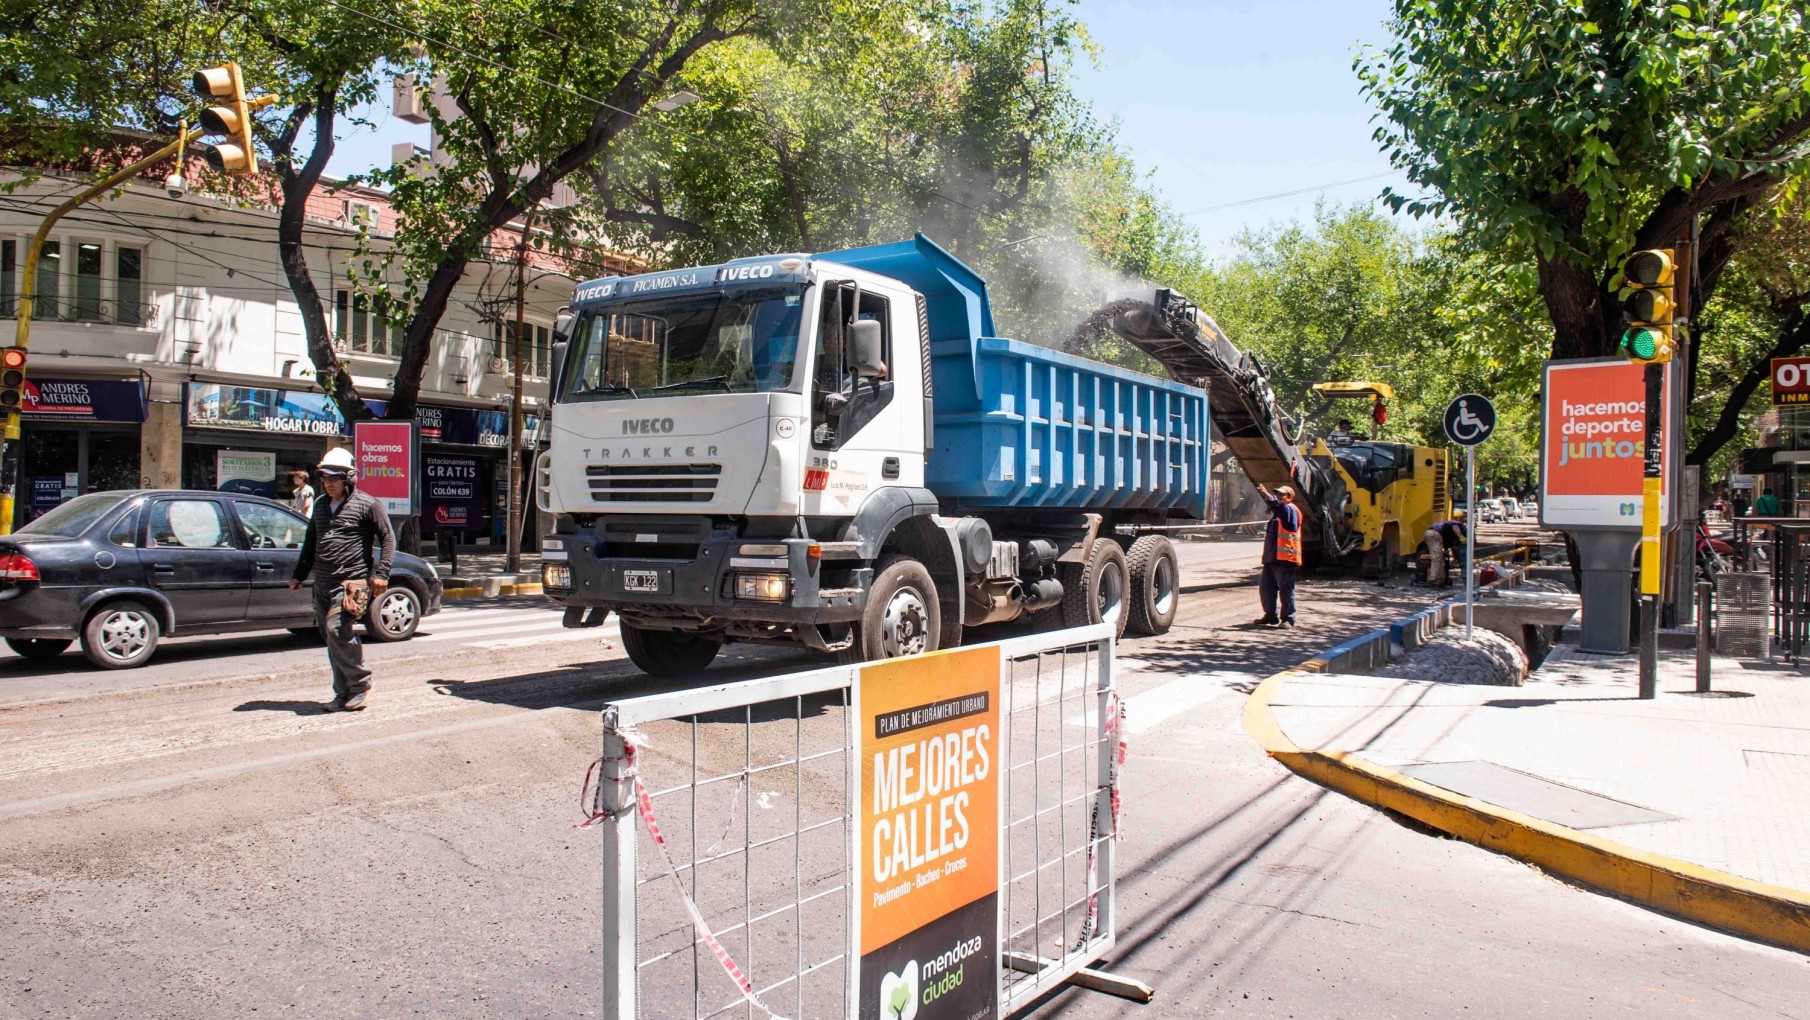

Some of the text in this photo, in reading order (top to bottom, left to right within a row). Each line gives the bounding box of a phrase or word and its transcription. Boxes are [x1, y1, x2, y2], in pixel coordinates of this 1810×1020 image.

[720, 264, 774, 282] IVECO
[632, 274, 698, 293] FICAMEN S.A.
[575, 284, 612, 303] IVECO
[40, 383, 89, 394] ANDRES
[42, 393, 91, 404] MERINO
[1781, 393, 1810, 402] INM
[416, 407, 442, 419] NDRES
[265, 416, 340, 435] HOGAR Y OBRA
[622, 418, 674, 435] IVECO
[1561, 417, 1643, 438] deporte
[362, 441, 402, 452] hacemos
[583, 445, 718, 459] TRAKKER
[1559, 436, 1645, 466] juntos
[263, 456, 271, 467] 3
[362, 452, 388, 462] obras
[427, 457, 475, 466] Estacionamiento
[361, 463, 404, 480] juntos.
[427, 466, 476, 478] GRATIS
[433, 486, 457, 496] COLÓN
[642, 575, 656, 588] 122
[880, 715, 899, 733] PLAN
[901, 713, 910, 729] DE
[961, 696, 985, 713] URBANO
[873, 723, 990, 816] MEJORES
[872, 791, 969, 884] CALLES
[873, 880, 911, 908] Pavimento
[916, 868, 940, 889] Bacheo
[944, 857, 967, 876] Cruces
[922, 935, 982, 981] mendoza
[922, 963, 964, 1005] ciudad
